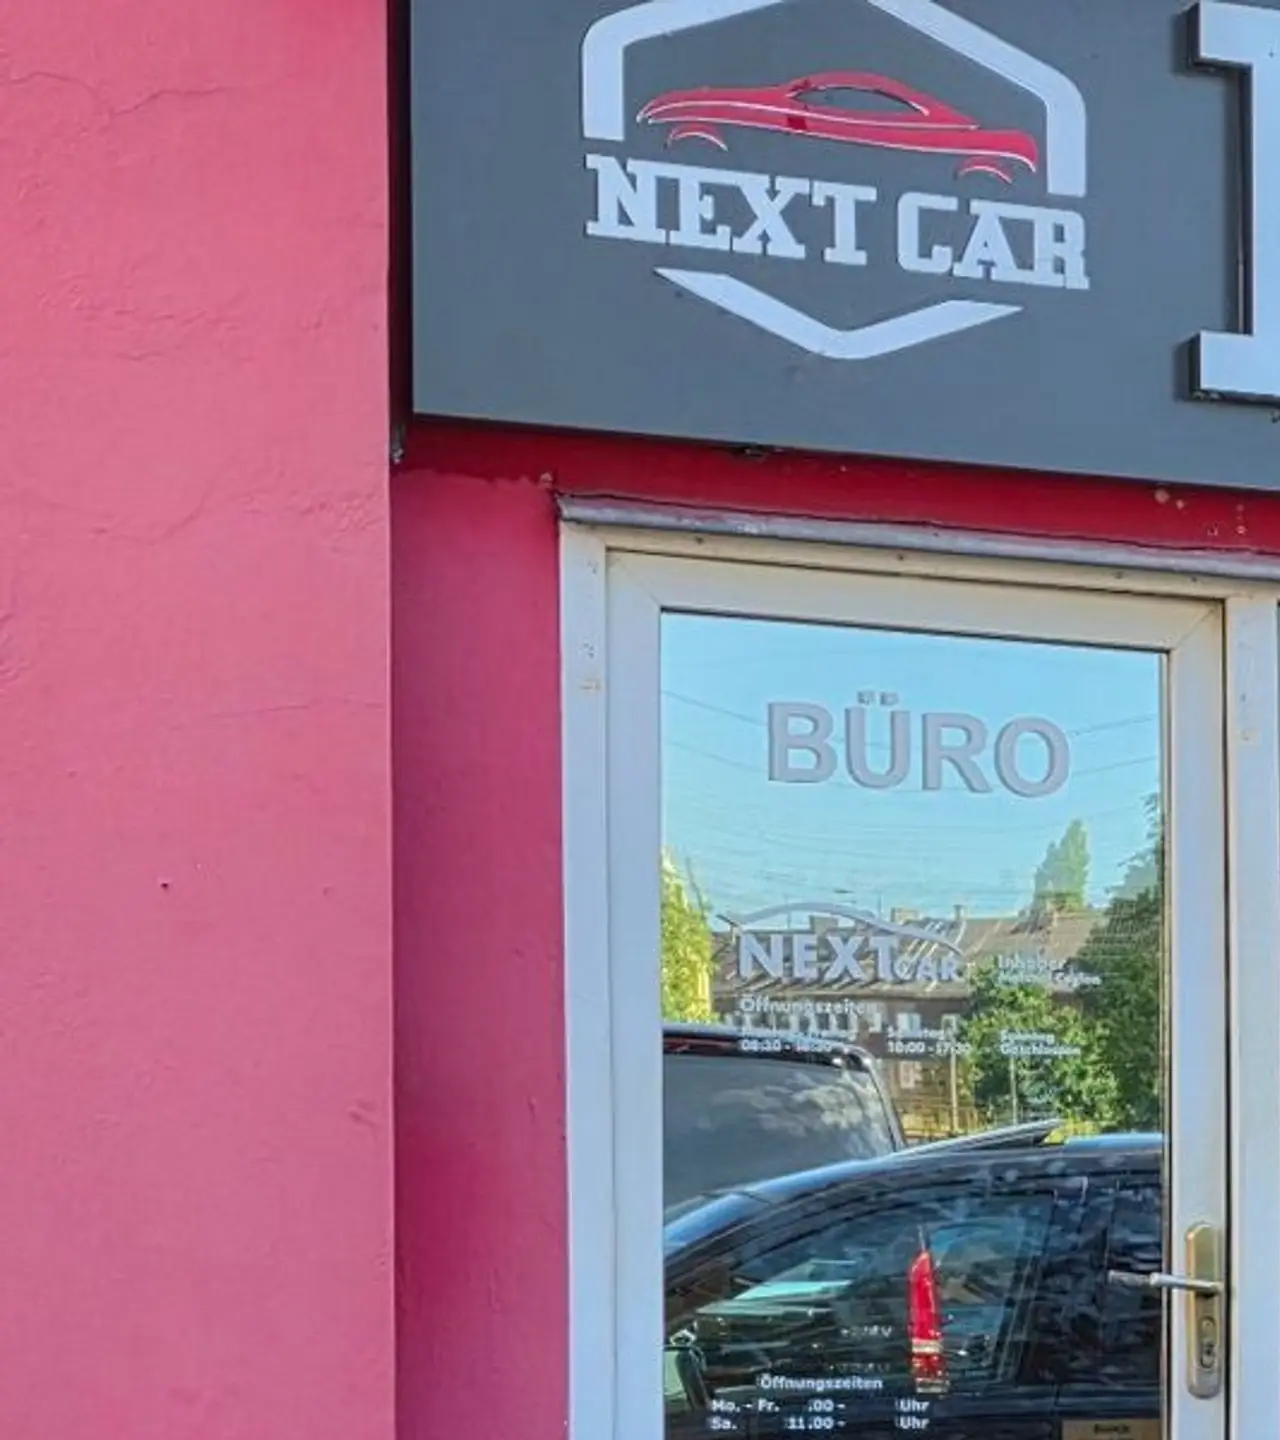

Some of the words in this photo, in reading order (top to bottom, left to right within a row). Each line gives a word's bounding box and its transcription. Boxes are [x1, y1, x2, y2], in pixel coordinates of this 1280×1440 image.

[585, 153, 877, 266] NEXT
[897, 191, 1090, 290] CAR
[767, 690, 1070, 798] BÜRO
[739, 933, 899, 982] NEXT
[759, 1373, 884, 1392] Öffnungszeiten
[711, 1416, 738, 1430] Sa.
[899, 1416, 930, 1430] Uhr
[899, 1399, 930, 1413] Uhr
